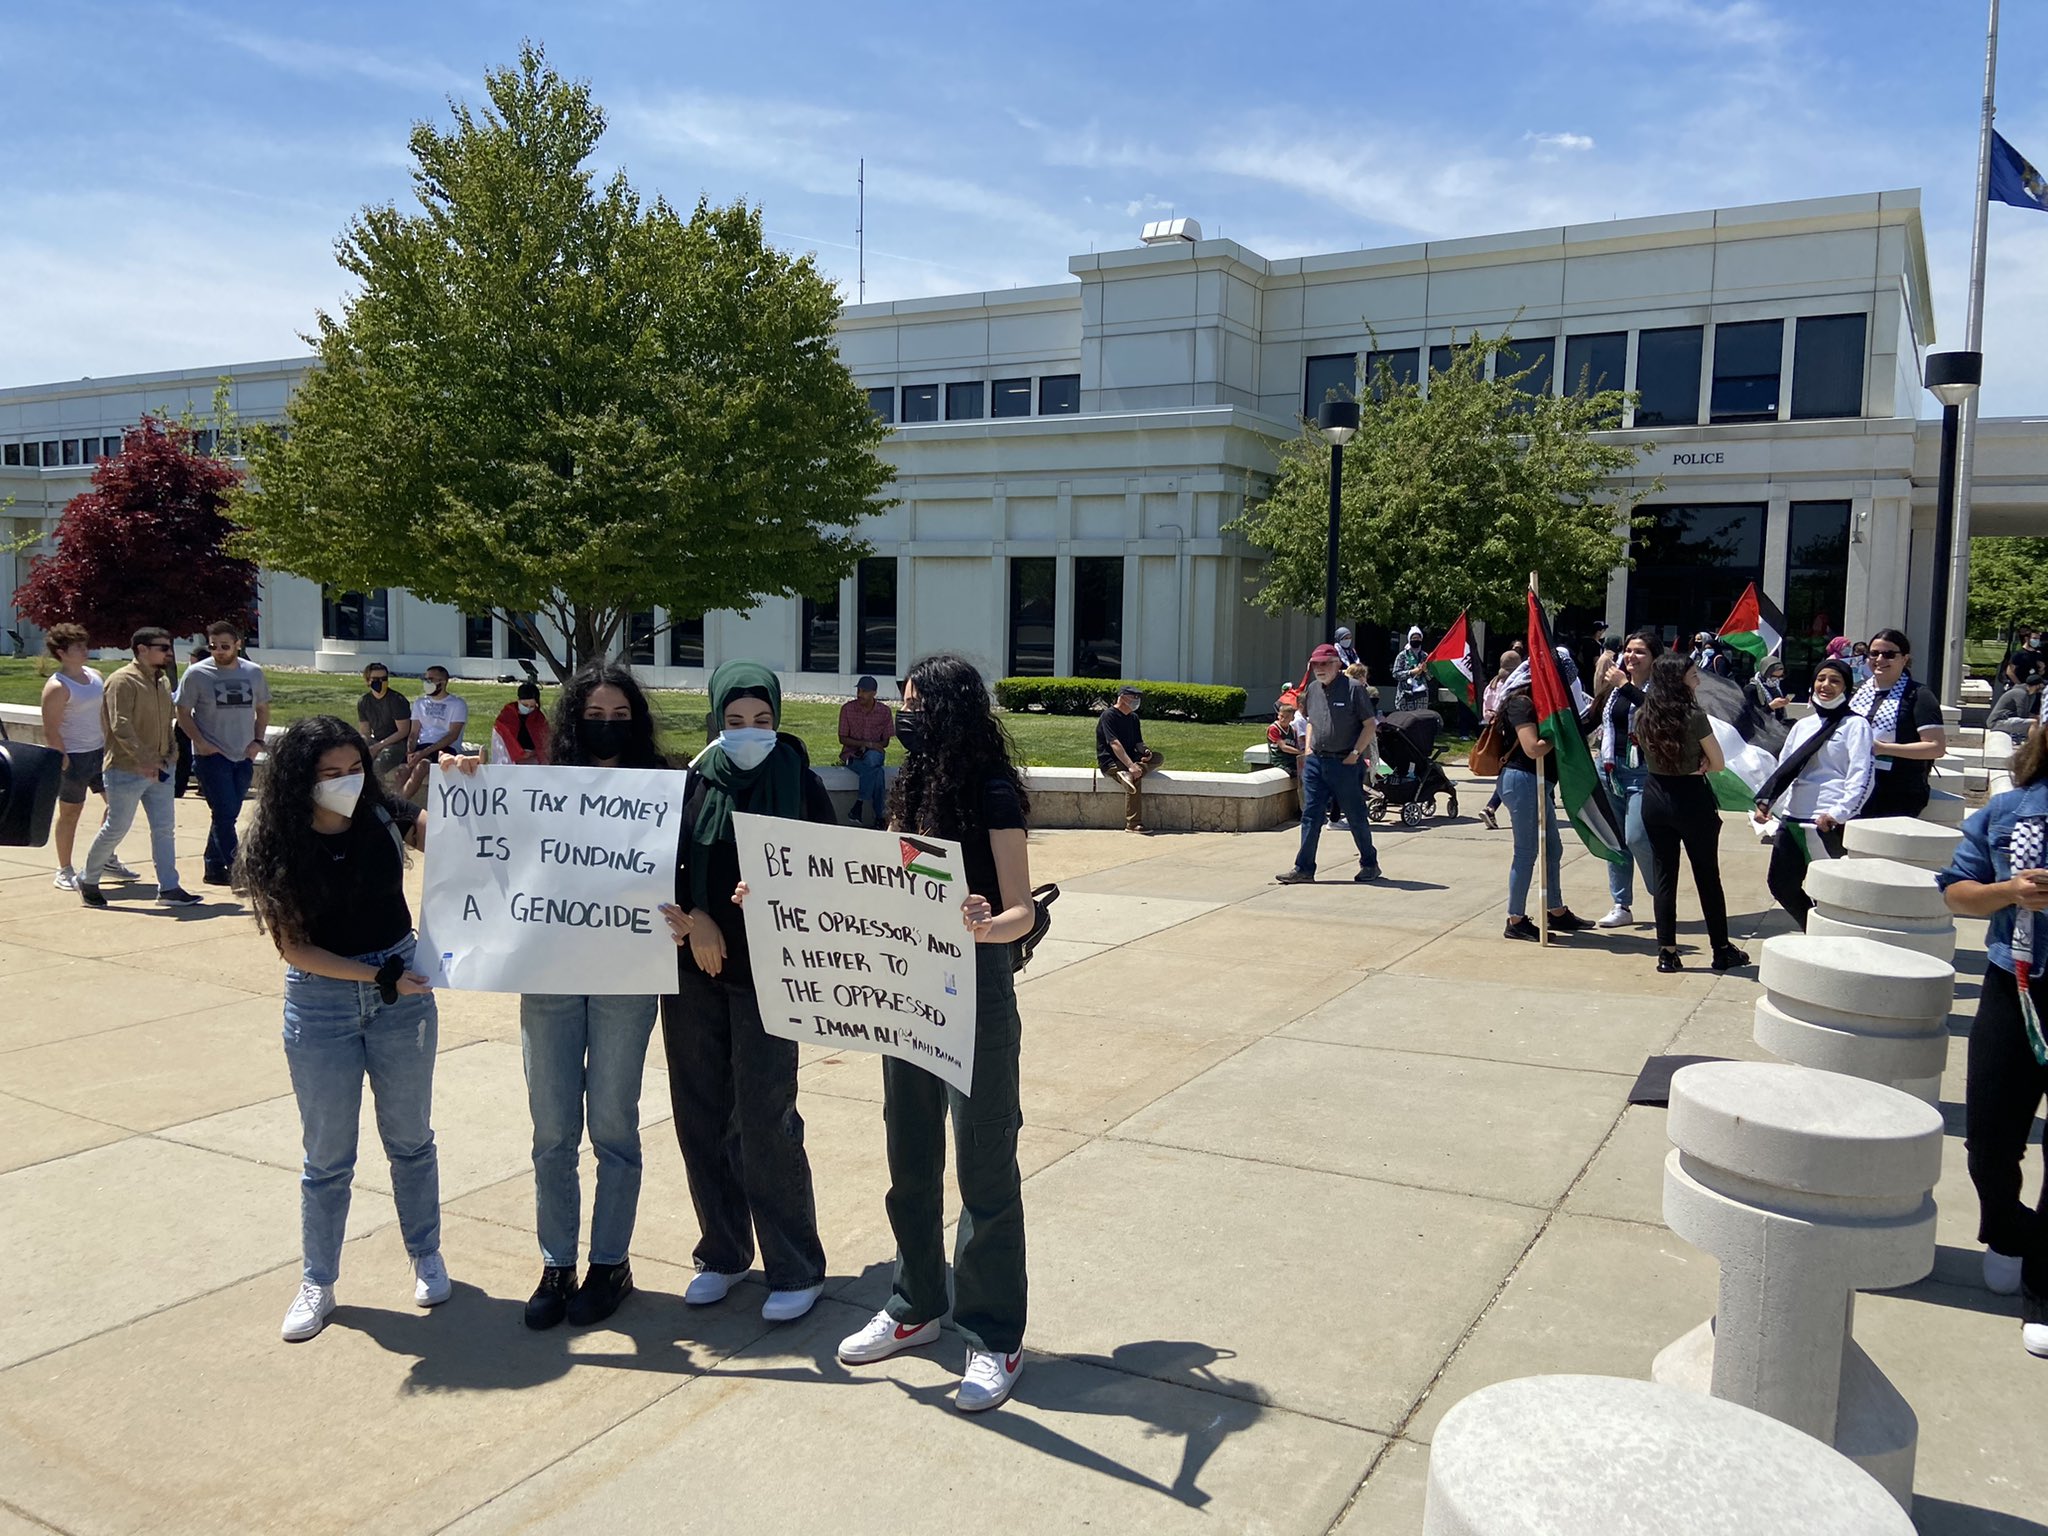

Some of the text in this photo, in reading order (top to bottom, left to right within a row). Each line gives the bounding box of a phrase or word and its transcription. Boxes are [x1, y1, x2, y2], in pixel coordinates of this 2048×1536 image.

[1673, 452, 1724, 465] POLICE
[438, 784, 668, 828] YOUR TAX MONEY
[476, 836, 656, 875] IS FUNDING
[764, 843, 948, 903] BE AN ENEMY OF
[463, 892, 652, 934] A GENOCIDE
[767, 900, 810, 932] THE
[927, 933, 962, 958] AND
[782, 946, 796, 968] A
[879, 952, 908, 976] TO
[781, 978, 947, 1027] THE OPPRESSED
[813, 1015, 870, 1040] IMAM
